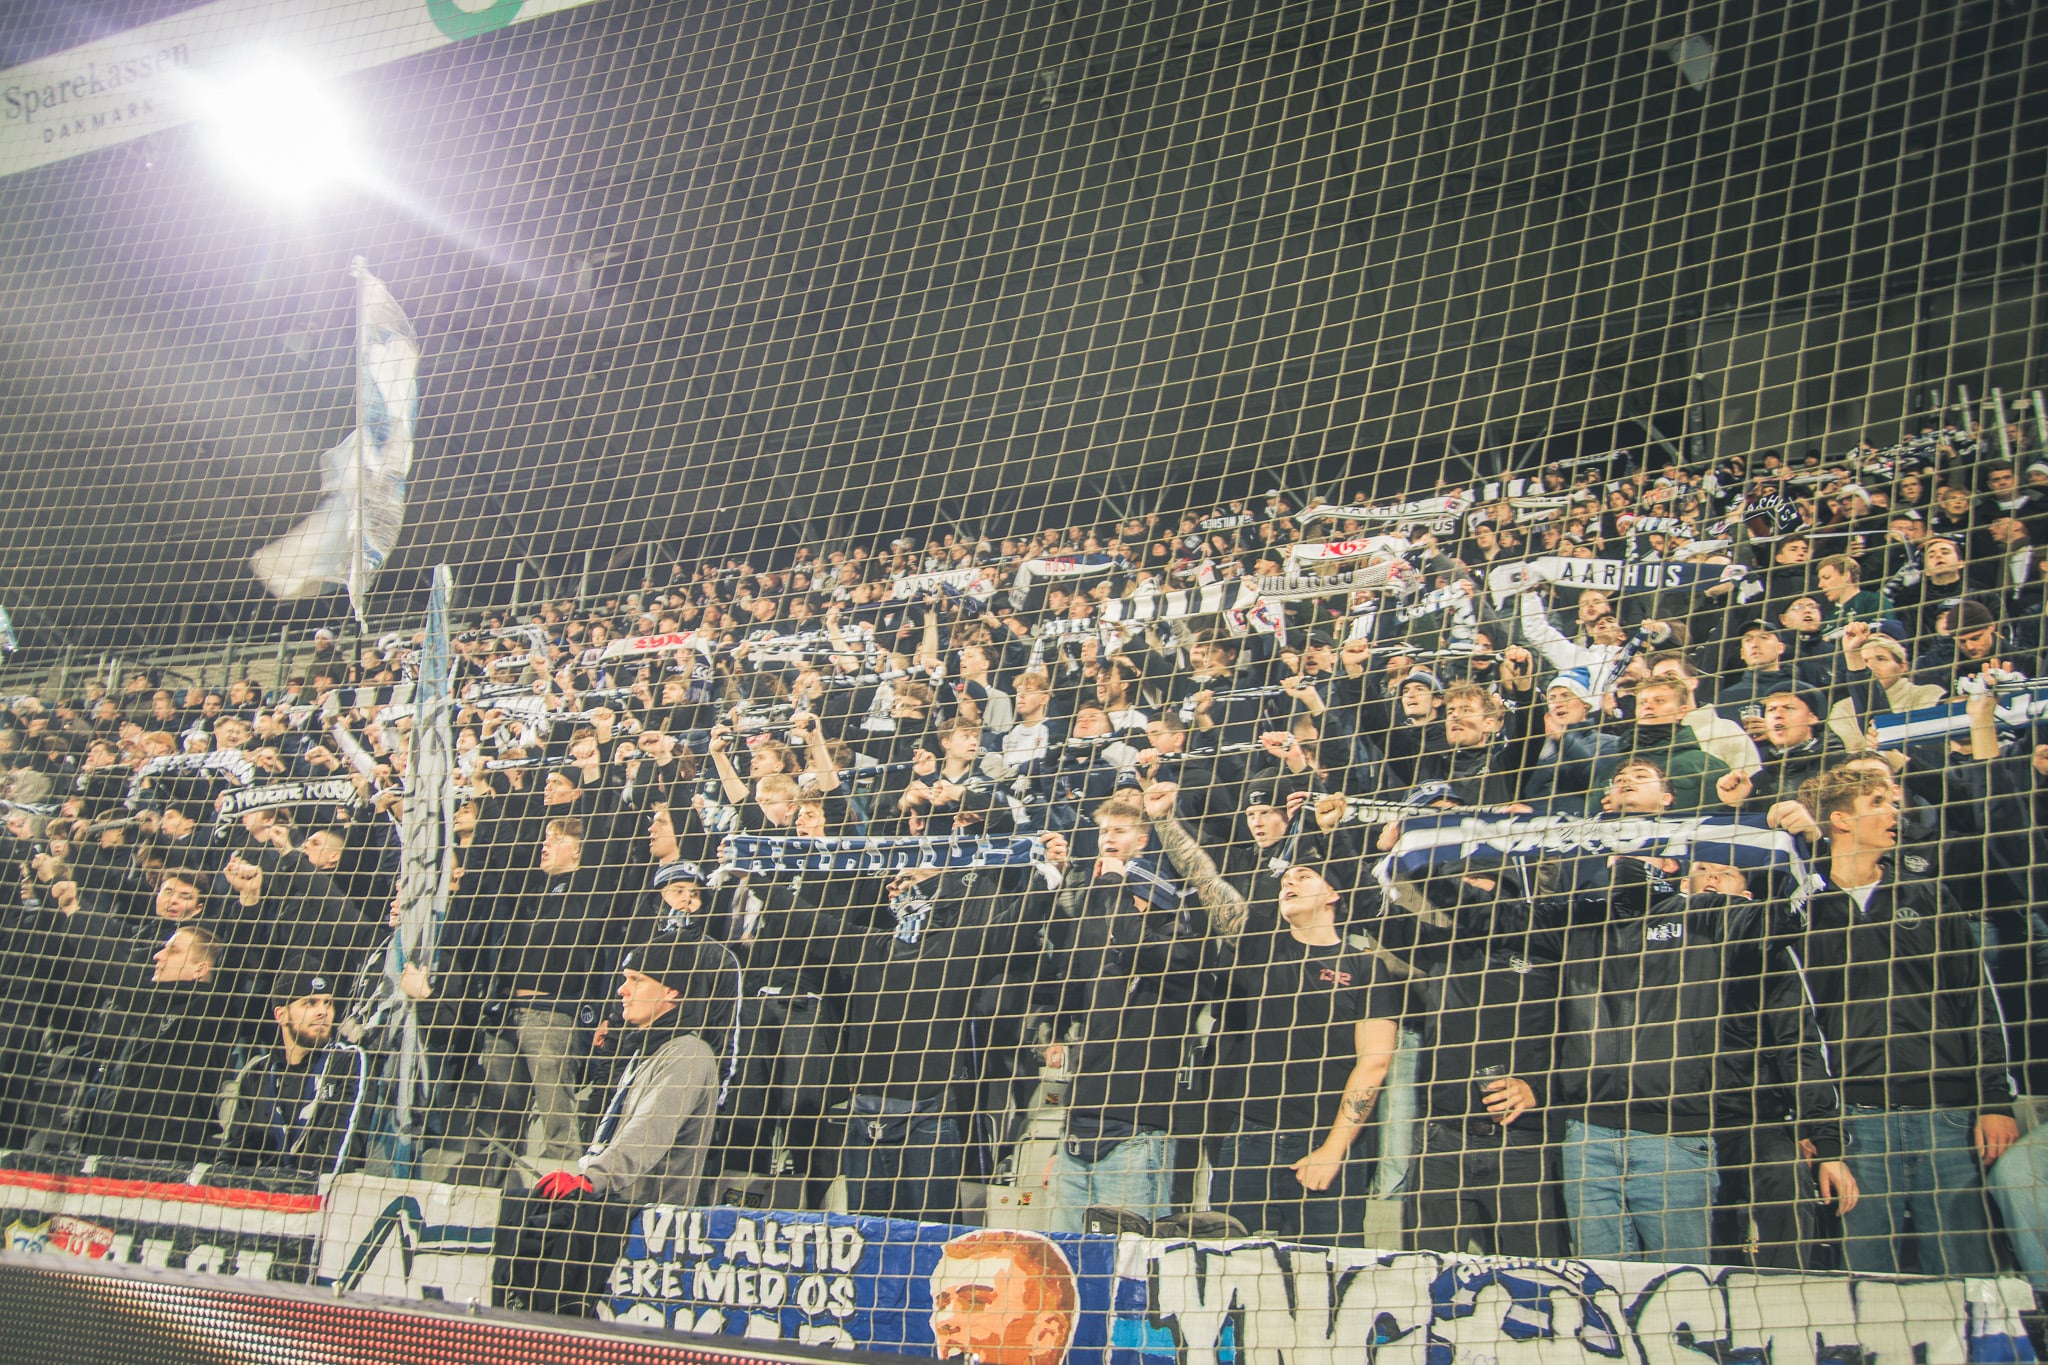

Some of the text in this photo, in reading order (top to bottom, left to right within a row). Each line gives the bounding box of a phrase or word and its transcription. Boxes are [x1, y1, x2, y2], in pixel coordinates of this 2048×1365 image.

[3, 43, 190, 123] Sparekassen
[43, 98, 155, 143] DANMARK
[1335, 500, 1420, 515] AARHUS
[1559, 561, 1681, 587] AARHUS
[642, 1208, 866, 1273] VIL ALTID
[692, 1260, 787, 1309] MED
[797, 1273, 857, 1318] OS
